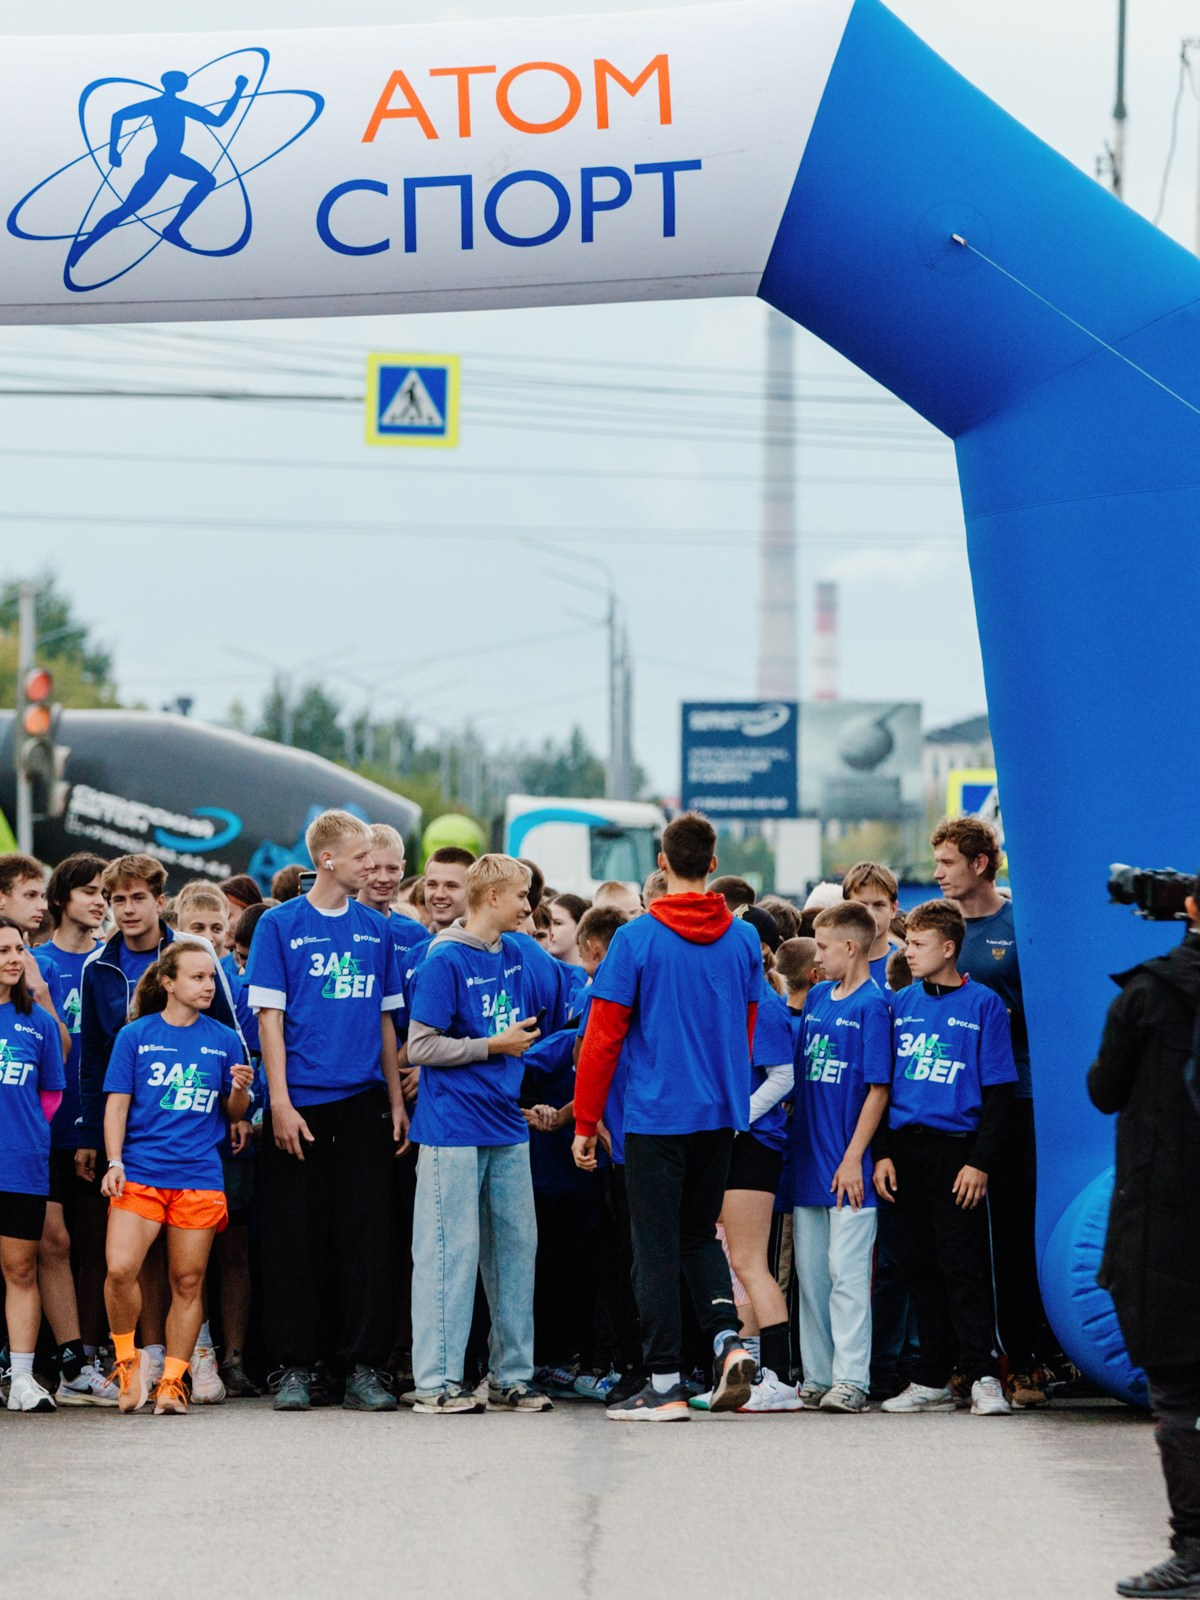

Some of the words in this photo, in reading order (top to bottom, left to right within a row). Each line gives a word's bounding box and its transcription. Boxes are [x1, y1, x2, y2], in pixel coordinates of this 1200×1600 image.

[361, 54, 672, 143] АТОМ
[316, 159, 702, 256] СПОРТ
[308, 951, 352, 977] ЗА!
[897, 1032, 940, 1058] ЗА!
[146, 1061, 198, 1087] ЗА!
[810, 1057, 849, 1084] БЕГ
[913, 1057, 966, 1085] БЕГ
[172, 1087, 218, 1113] БЕГ
